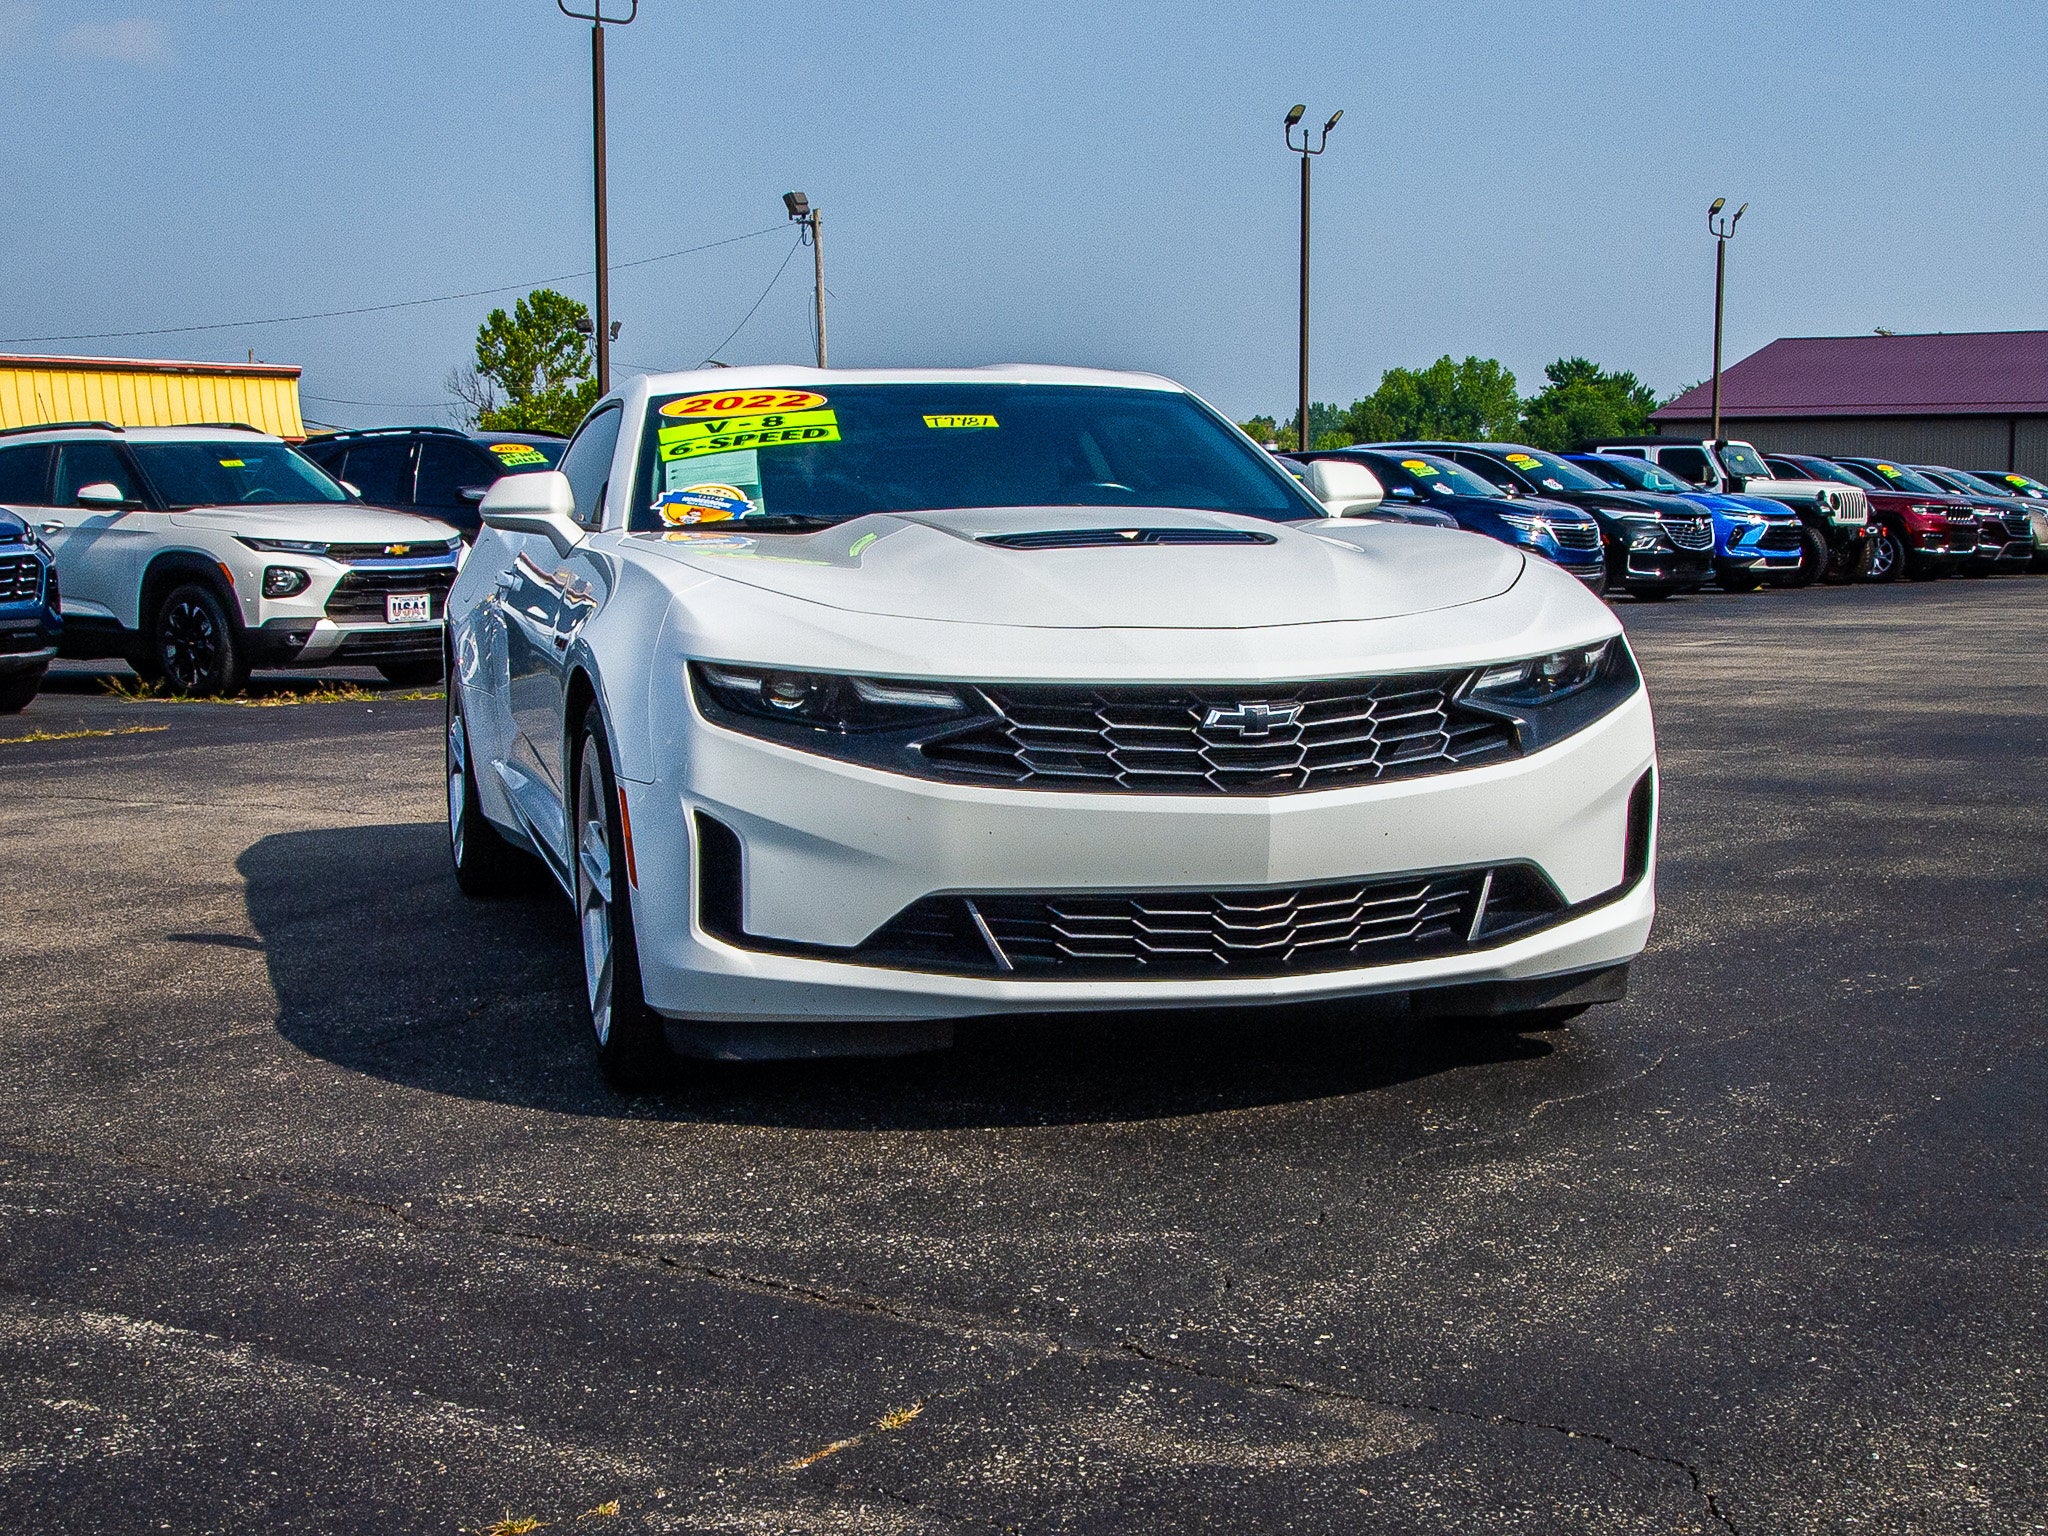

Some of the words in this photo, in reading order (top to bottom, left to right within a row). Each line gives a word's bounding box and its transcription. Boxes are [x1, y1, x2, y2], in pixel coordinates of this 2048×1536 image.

[679, 394, 811, 414] 2022
[669, 427, 829, 456] 6-SPEED
[392, 601, 426, 617] USA1
